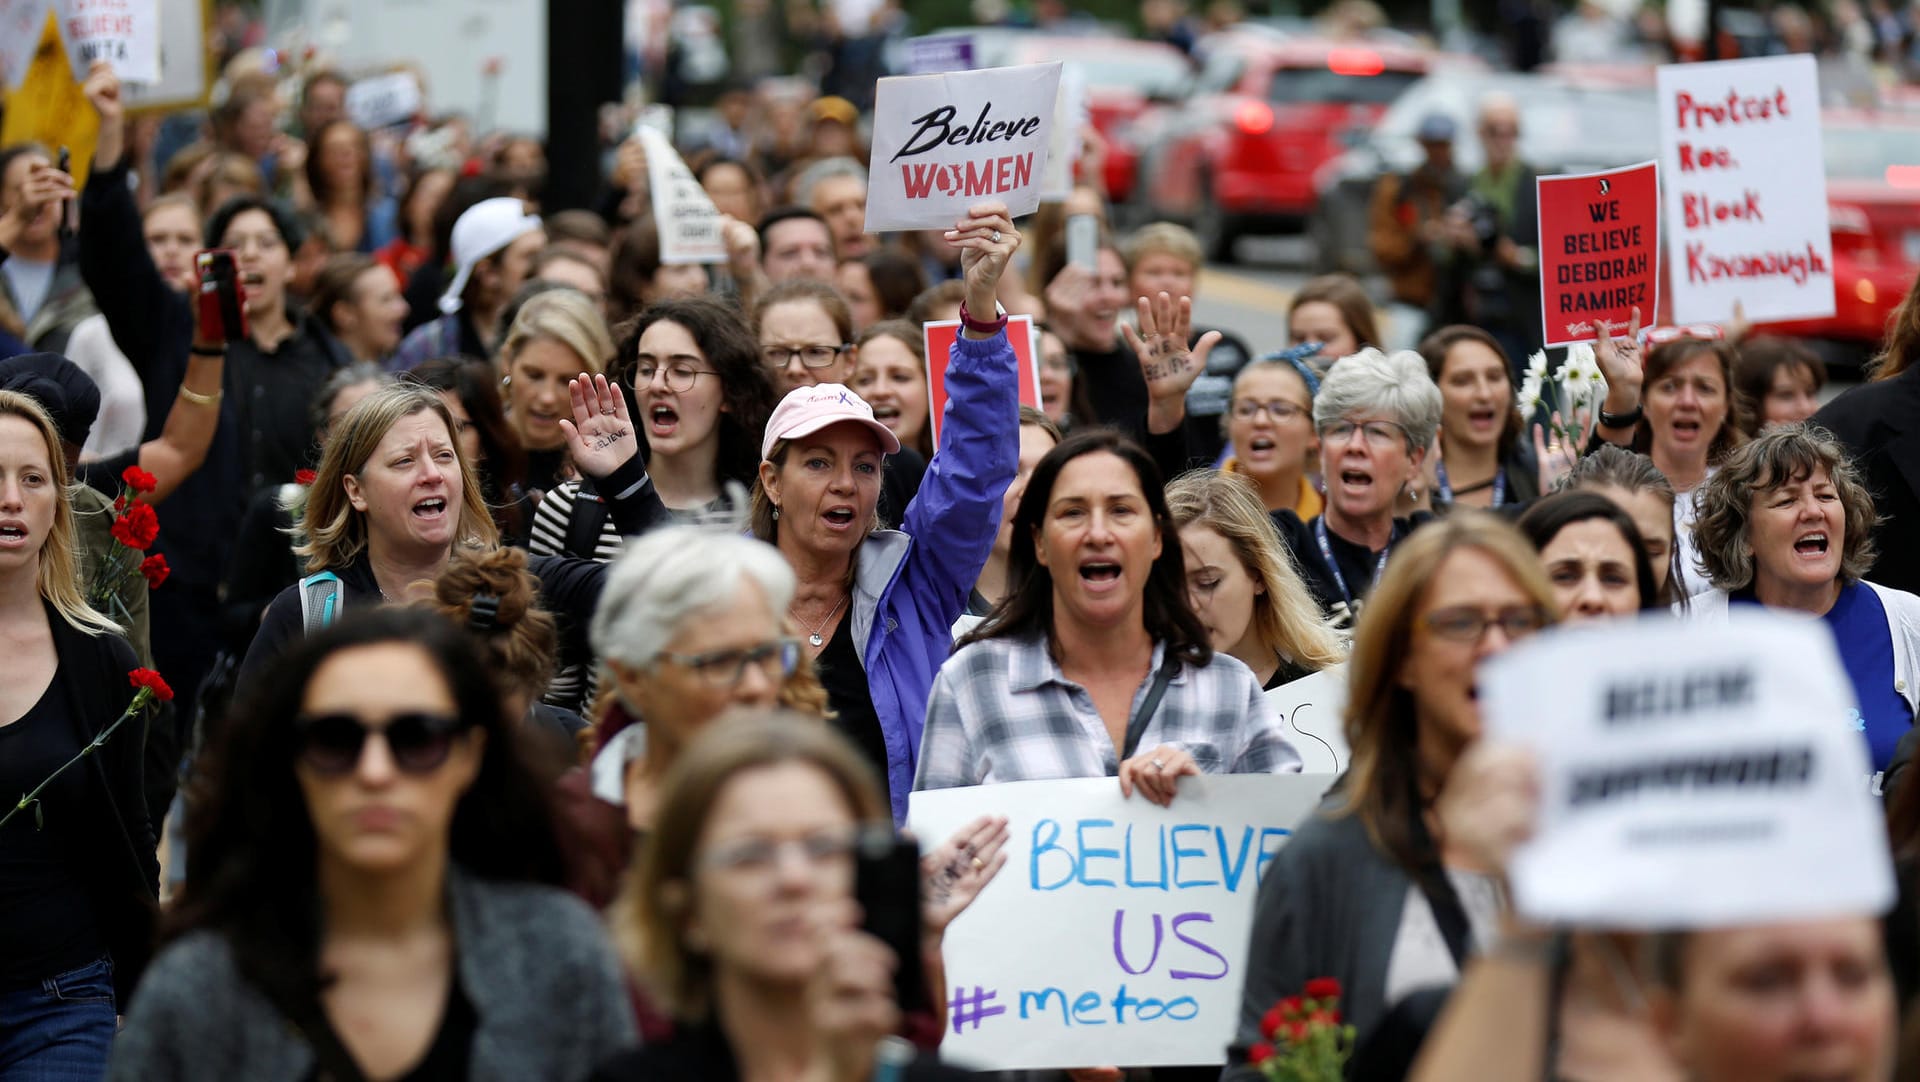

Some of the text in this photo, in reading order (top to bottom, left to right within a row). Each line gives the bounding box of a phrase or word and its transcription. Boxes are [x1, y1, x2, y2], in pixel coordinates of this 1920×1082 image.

[889, 101, 1040, 163] Believe
[901, 151, 1033, 199] WOMEN
[1588, 200, 1620, 222] WE
[1564, 226, 1641, 254] BELIEVE
[1558, 253, 1647, 284] DEBORAH
[1685, 241, 1830, 285] Kavanaugh
[1560, 283, 1646, 313] RAMIREZ
[1029, 818, 1292, 892] BELIEVE
[1113, 909, 1228, 980] US
